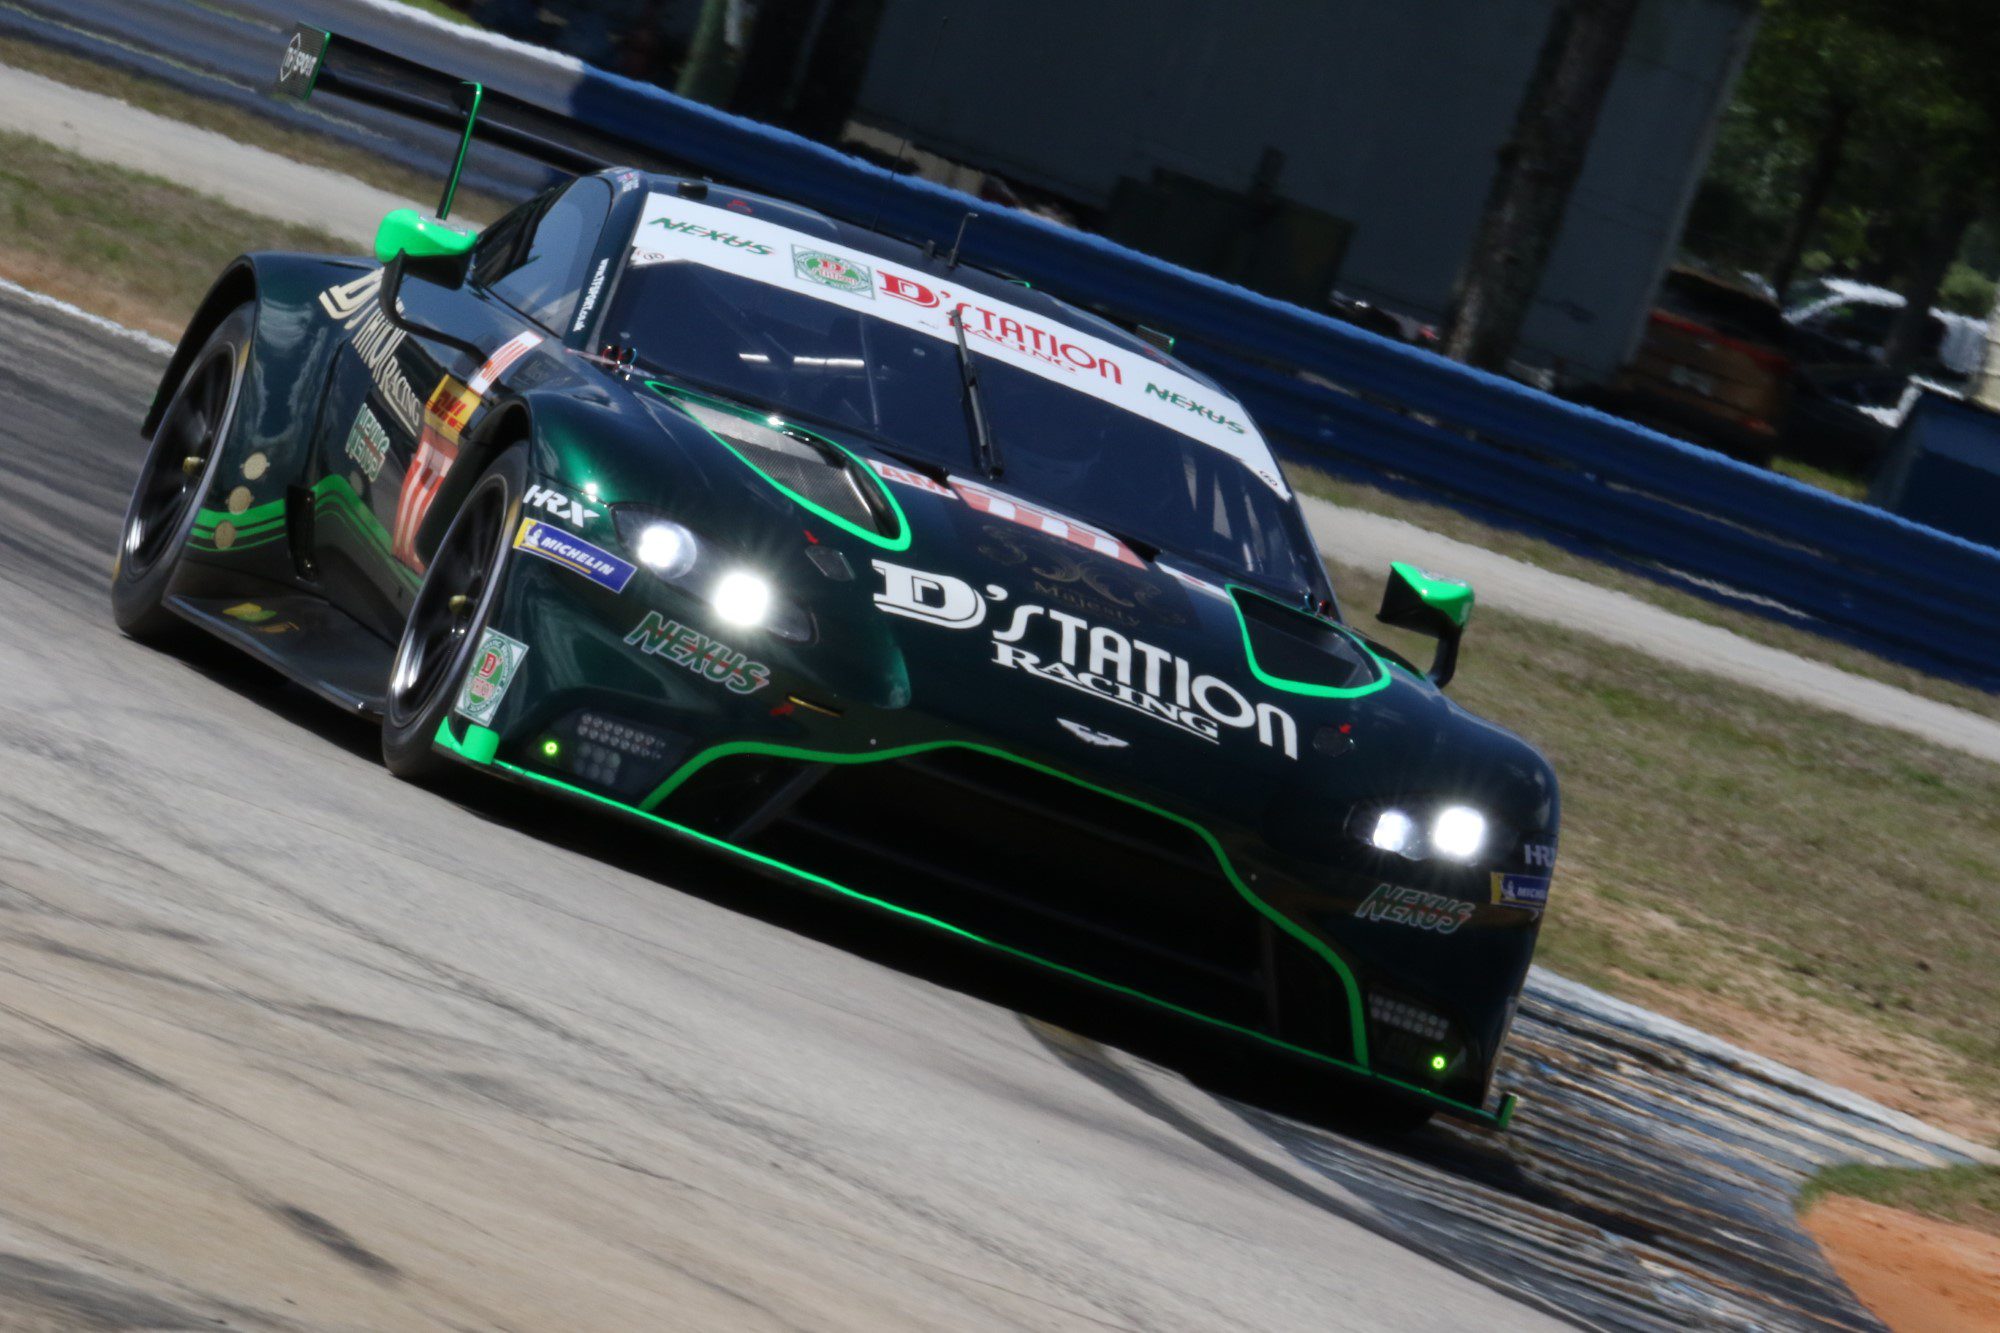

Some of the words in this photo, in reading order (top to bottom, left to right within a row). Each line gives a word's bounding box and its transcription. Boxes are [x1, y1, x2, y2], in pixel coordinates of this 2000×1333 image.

[648, 216, 775, 255] NEXUS
[876, 269, 1122, 385] D'STATION
[948, 317, 1077, 372] RACING
[378, 355, 421, 429] RACING
[1144, 382, 1247, 435] NEXUS
[344, 402, 390, 482] NEXUS
[522, 484, 600, 528] HRX
[540, 535, 615, 577] MICHELIN
[622, 610, 771, 695] NEXUS
[871, 558, 1299, 761] D'STATION
[991, 640, 1220, 740] RACING
[1354, 883, 1476, 934] NEXUS
